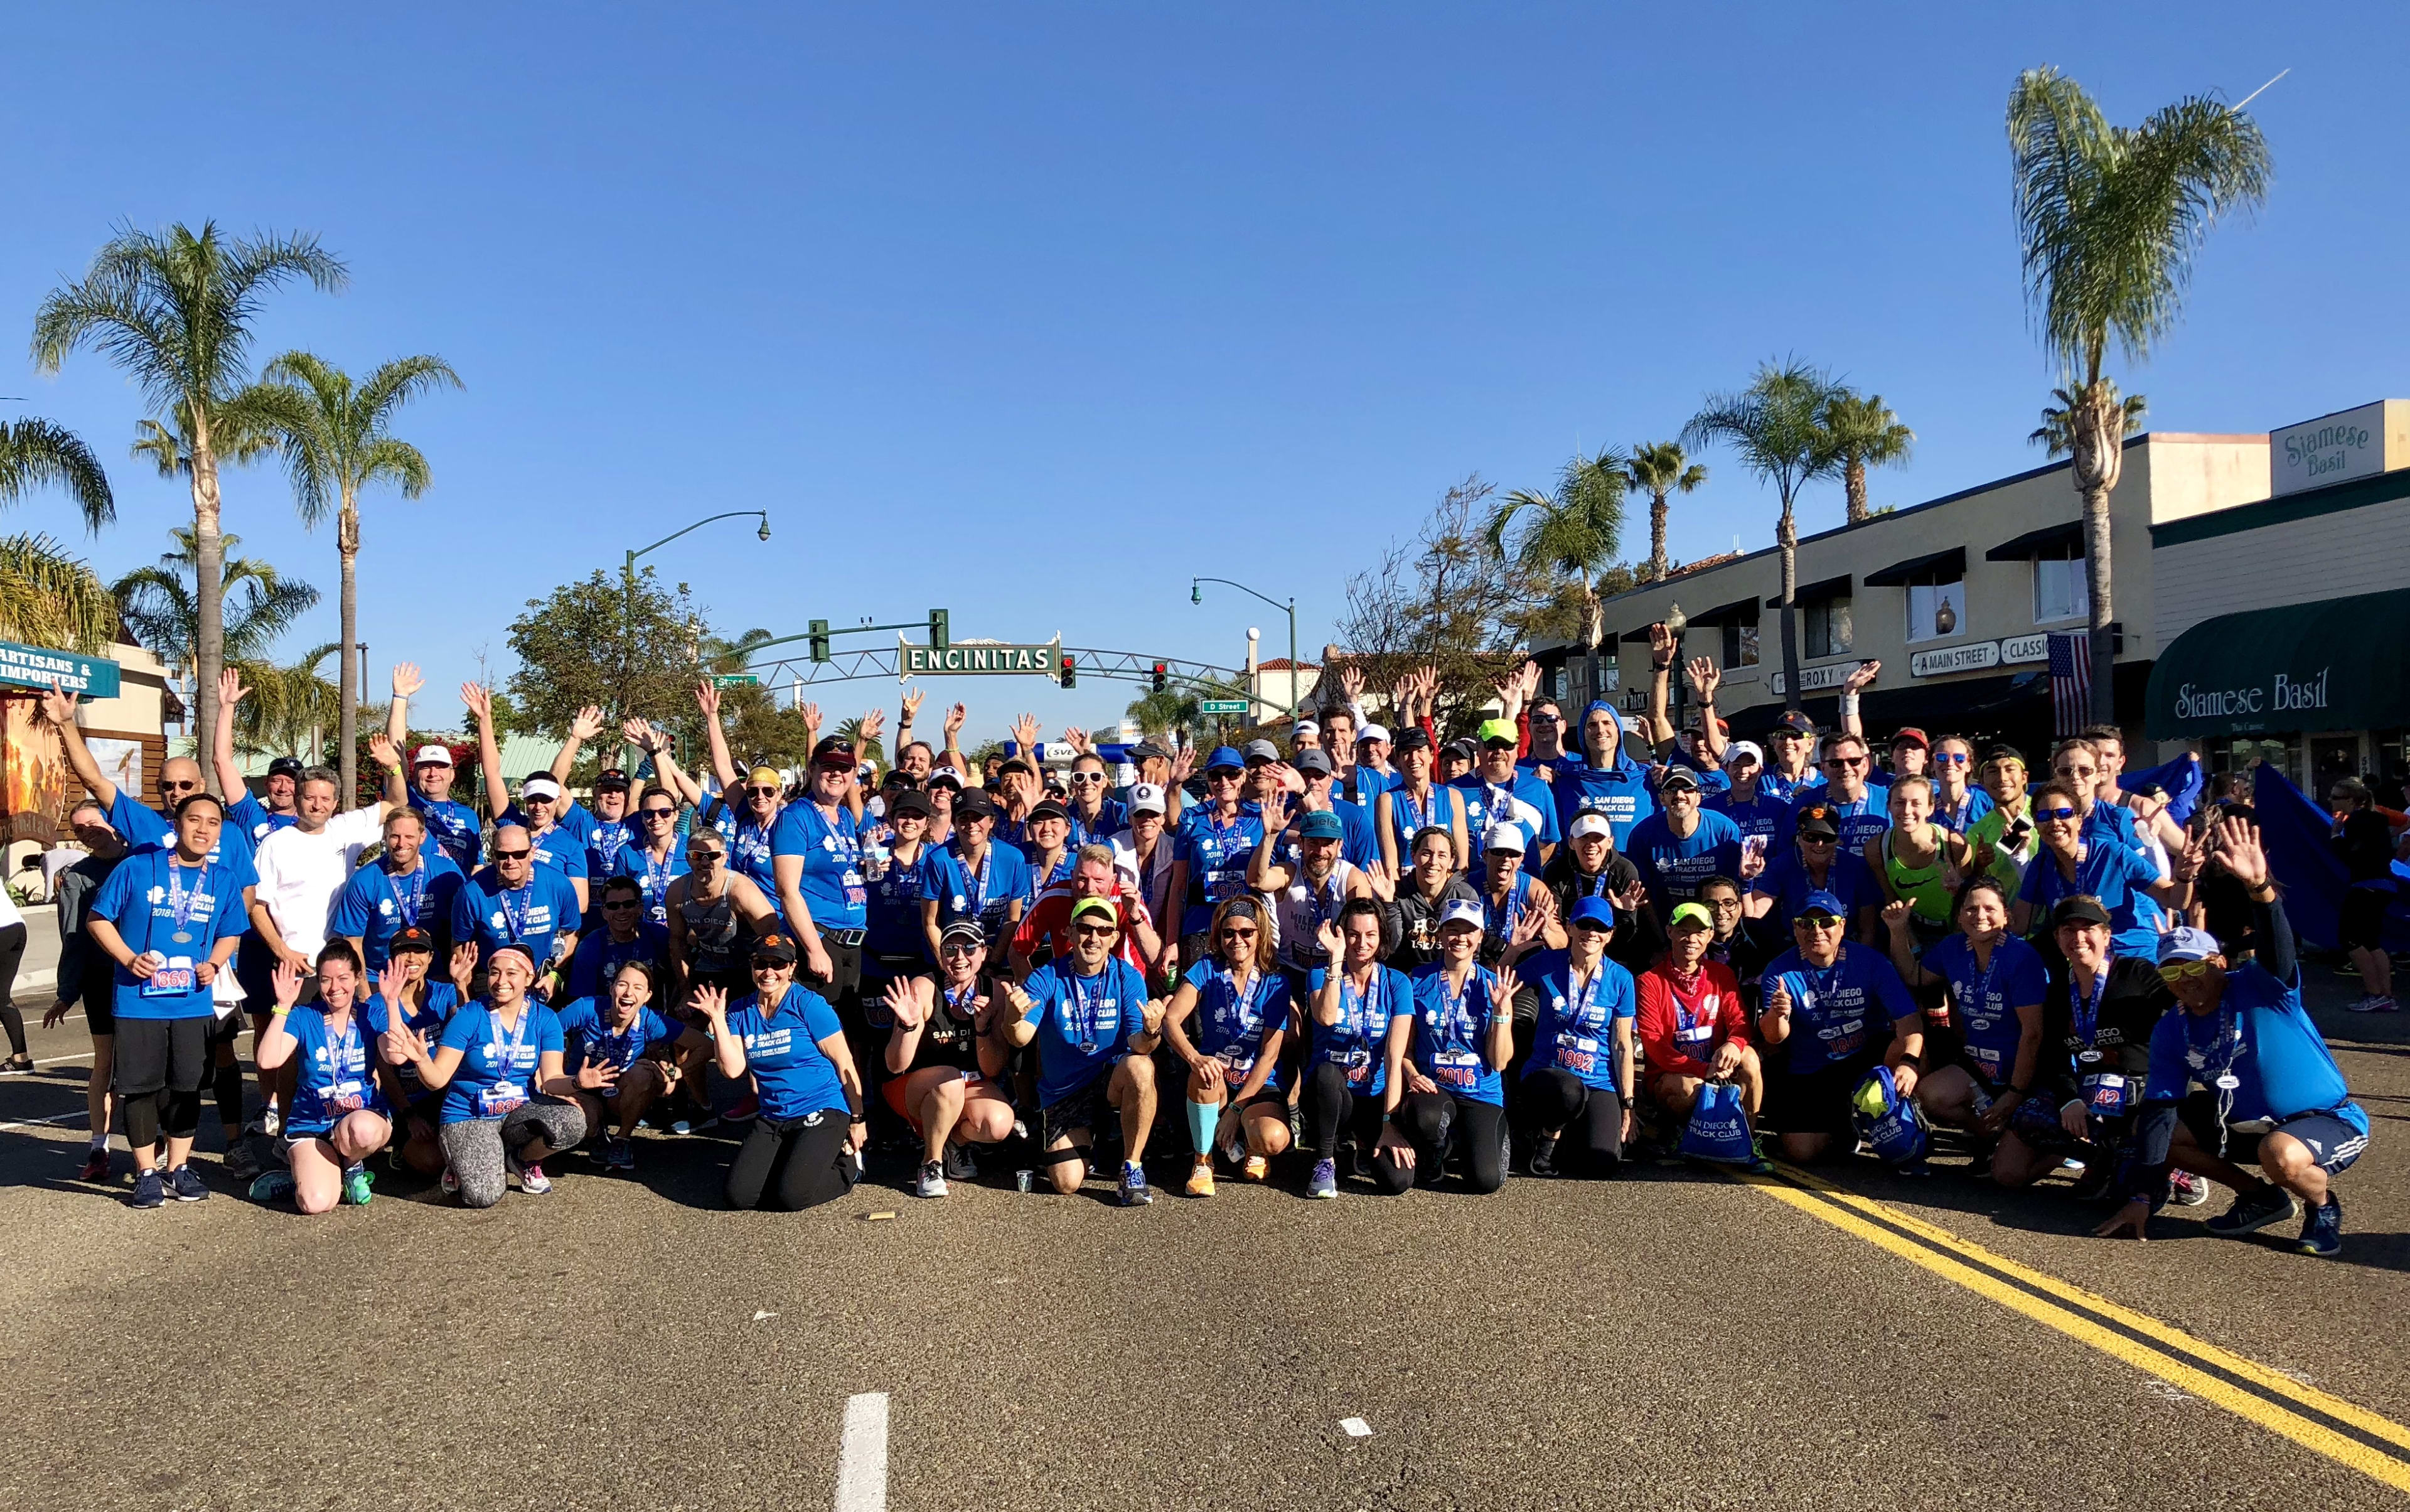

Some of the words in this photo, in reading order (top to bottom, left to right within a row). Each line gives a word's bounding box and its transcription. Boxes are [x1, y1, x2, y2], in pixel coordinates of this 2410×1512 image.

[2284, 424, 2369, 468] Siamese
[2308, 450, 2346, 477] Basil
[0, 649, 73, 673] ARTISANS
[81, 664, 92, 677] &
[911, 649, 1049, 669] ENCINITAS
[1921, 657, 1928, 671] A
[1929, 653, 1954, 670] MAIN
[1955, 647, 1988, 666] STREET
[0, 664, 88, 689] IMPORTERS
[1806, 668, 1833, 687] ROXY
[2175, 684, 2263, 719] Siamese
[2273, 666, 2329, 710] Basil
[1593, 796, 1611, 804] SAN
[1610, 796, 1636, 804] DIEGO
[1206, 850, 1221, 859] 2018
[1691, 856, 1715, 865] DIEGO
[1698, 864, 1716, 872] CLUB
[1210, 882, 1245, 898] 1972
[152, 908, 172, 917] 2018
[532, 913, 551, 925] CLUB
[704, 918, 733, 927] DIEGO
[151, 970, 190, 988] 1869
[1836, 987, 1862, 999] DIEGO
[1099, 998, 1117, 1008] EGO
[1844, 997, 1865, 1006] CLUB
[1097, 1008, 1117, 1017] CLUB
[1588, 1013, 1605, 1022] CLUB
[932, 1029, 956, 1039] SAN
[1247, 1024, 1263, 1032] CLUB
[1334, 1026, 1351, 1035] 2018
[757, 1032, 771, 1041] SAN
[771, 1028, 791, 1038] DIEGO
[757, 1039, 776, 1048] TRACK
[776, 1036, 791, 1044] CLUB
[2097, 1036, 2124, 1046] CLUB
[747, 1051, 761, 1059] 2018
[1556, 1048, 1594, 1071] 1992
[1223, 1069, 1249, 1085] 064
[1436, 1066, 1474, 1086] 2016
[322, 1094, 363, 1118] 1880
[1703, 1121, 1730, 1129] DIEGO
[1688, 1125, 1716, 1138] TRACK
[1718, 1129, 1742, 1138] CLUB
[1880, 1125, 1902, 1139] CLUB
